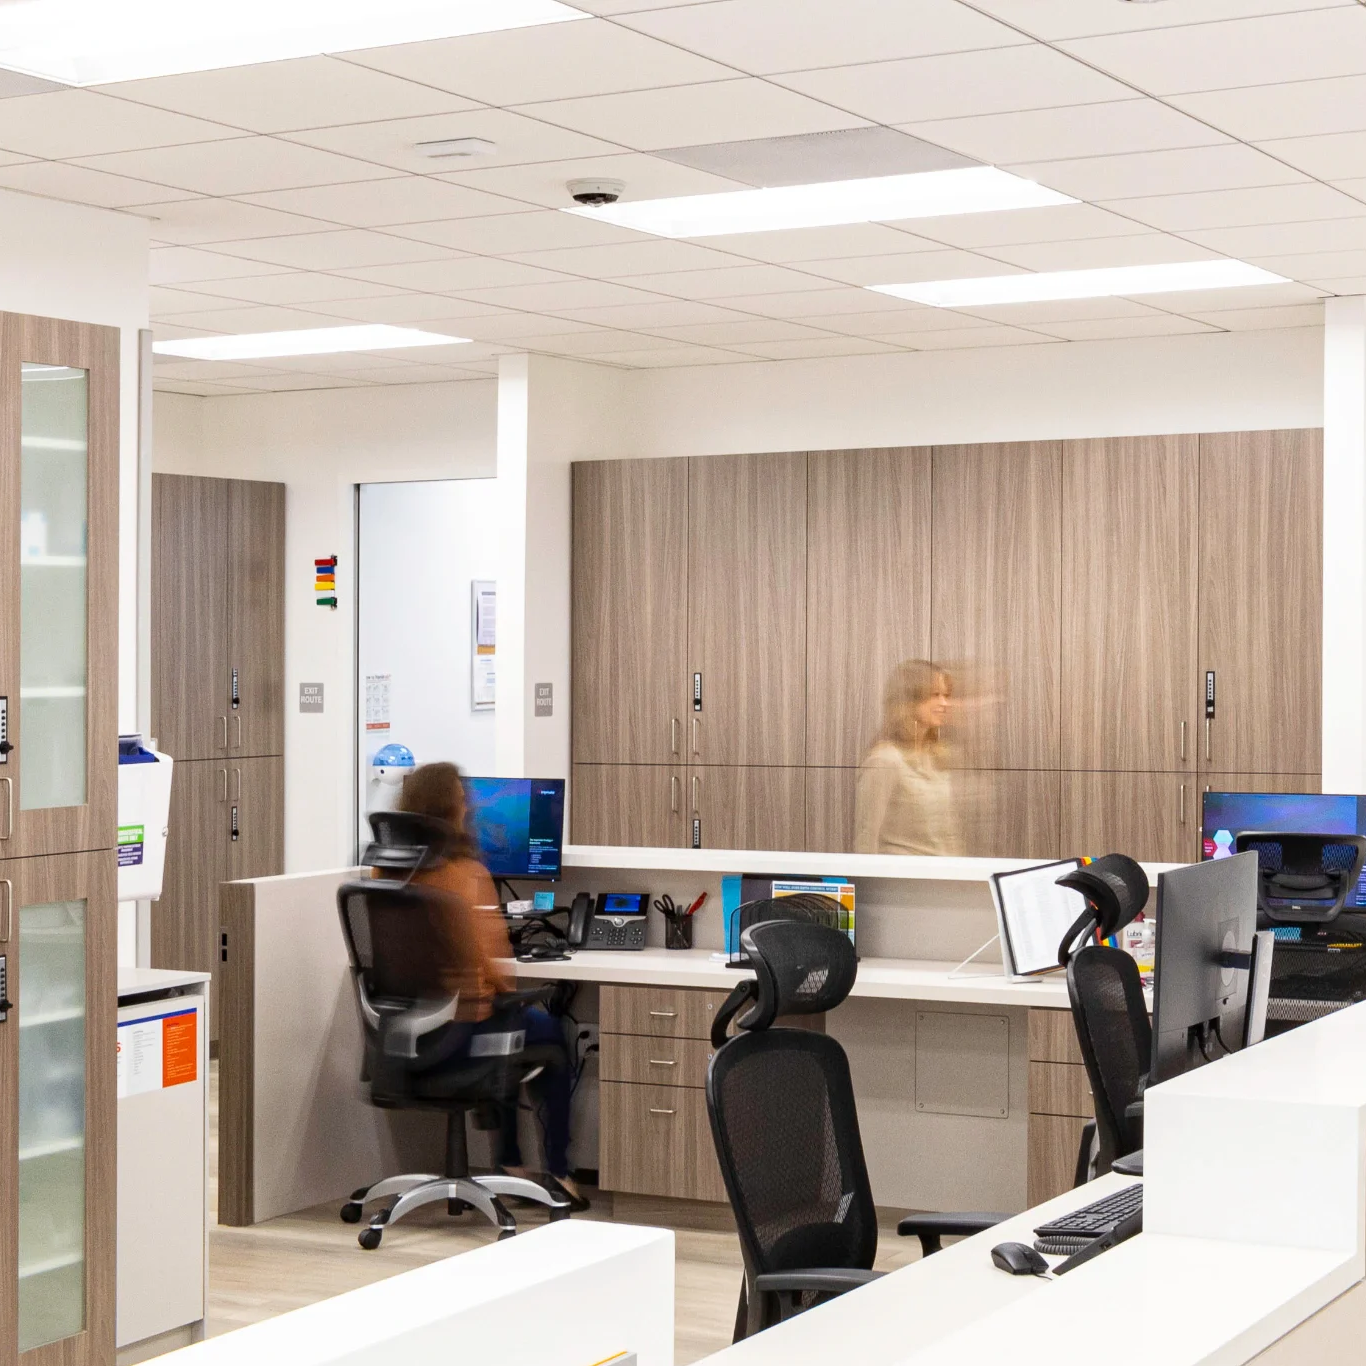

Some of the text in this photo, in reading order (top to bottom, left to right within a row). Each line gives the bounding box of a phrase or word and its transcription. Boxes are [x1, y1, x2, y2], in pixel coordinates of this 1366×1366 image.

[304, 687, 318, 695] EXIT
[539, 687, 549, 696] EXIT
[300, 695, 323, 704] ROUTE
[536, 697, 552, 706] ROUTE
